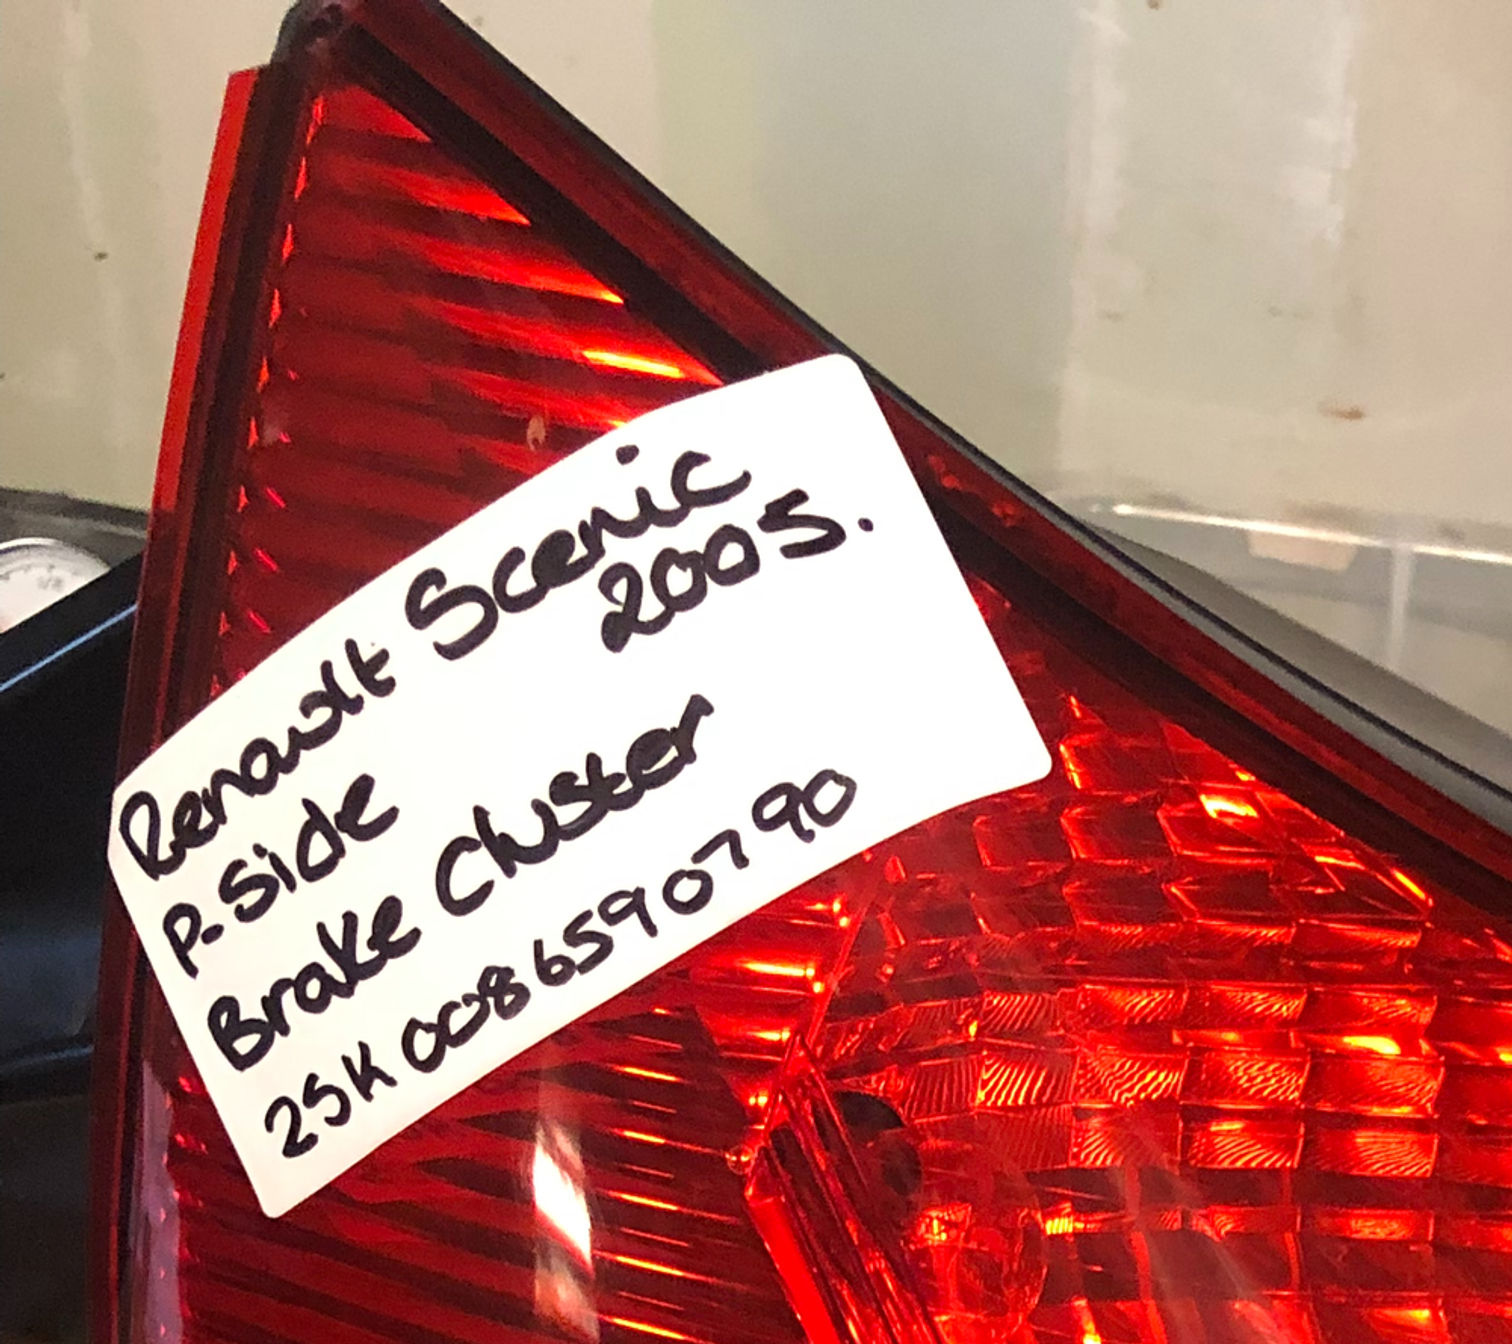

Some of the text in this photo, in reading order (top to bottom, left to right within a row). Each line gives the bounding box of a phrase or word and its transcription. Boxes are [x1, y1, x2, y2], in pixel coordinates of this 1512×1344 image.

[119, 445, 752, 881] Renault Scenic
[207, 694, 714, 1071] Brake Cluster
